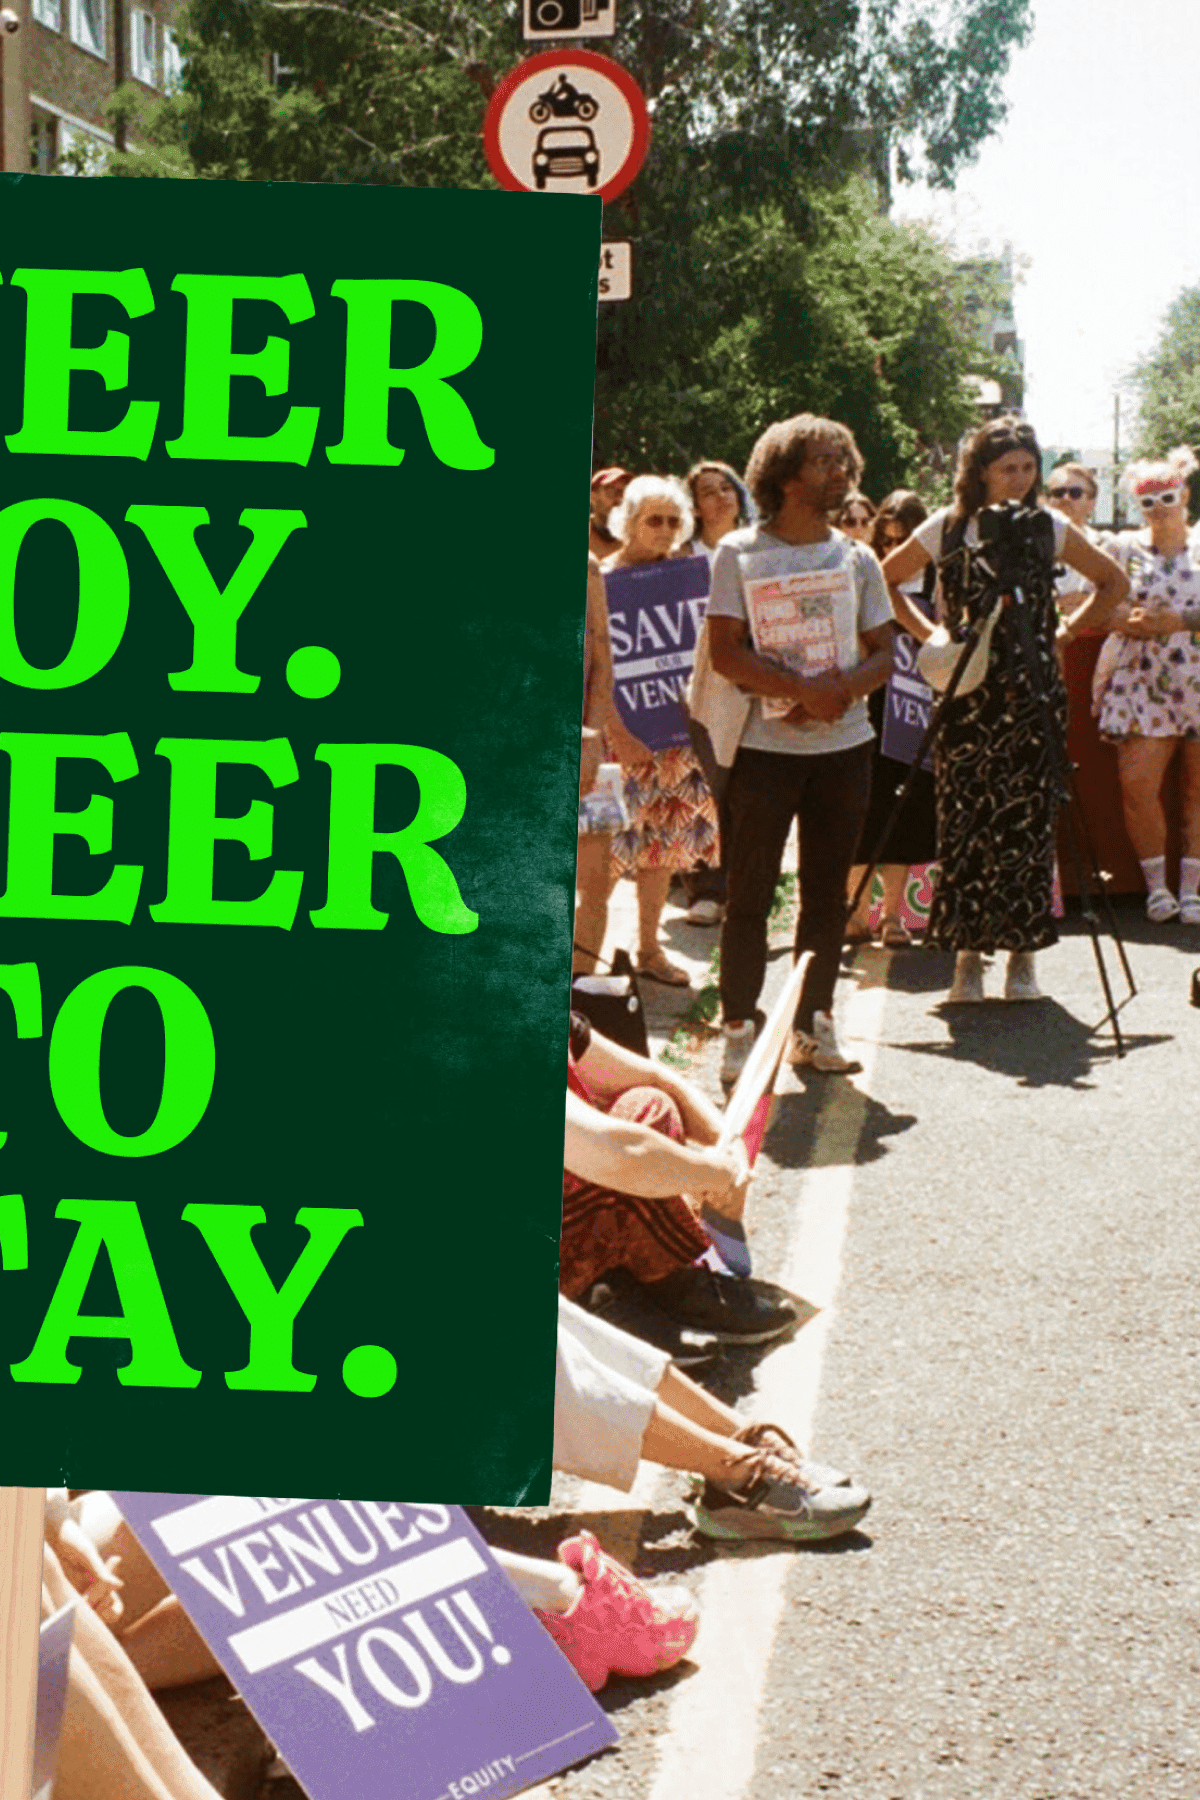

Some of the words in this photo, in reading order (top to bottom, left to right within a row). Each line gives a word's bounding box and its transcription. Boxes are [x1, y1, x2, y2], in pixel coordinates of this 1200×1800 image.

[323, 1576, 400, 1630] NEED
[294, 1588, 512, 1734] YOU!
[448, 1754, 516, 1800] EQUITY
